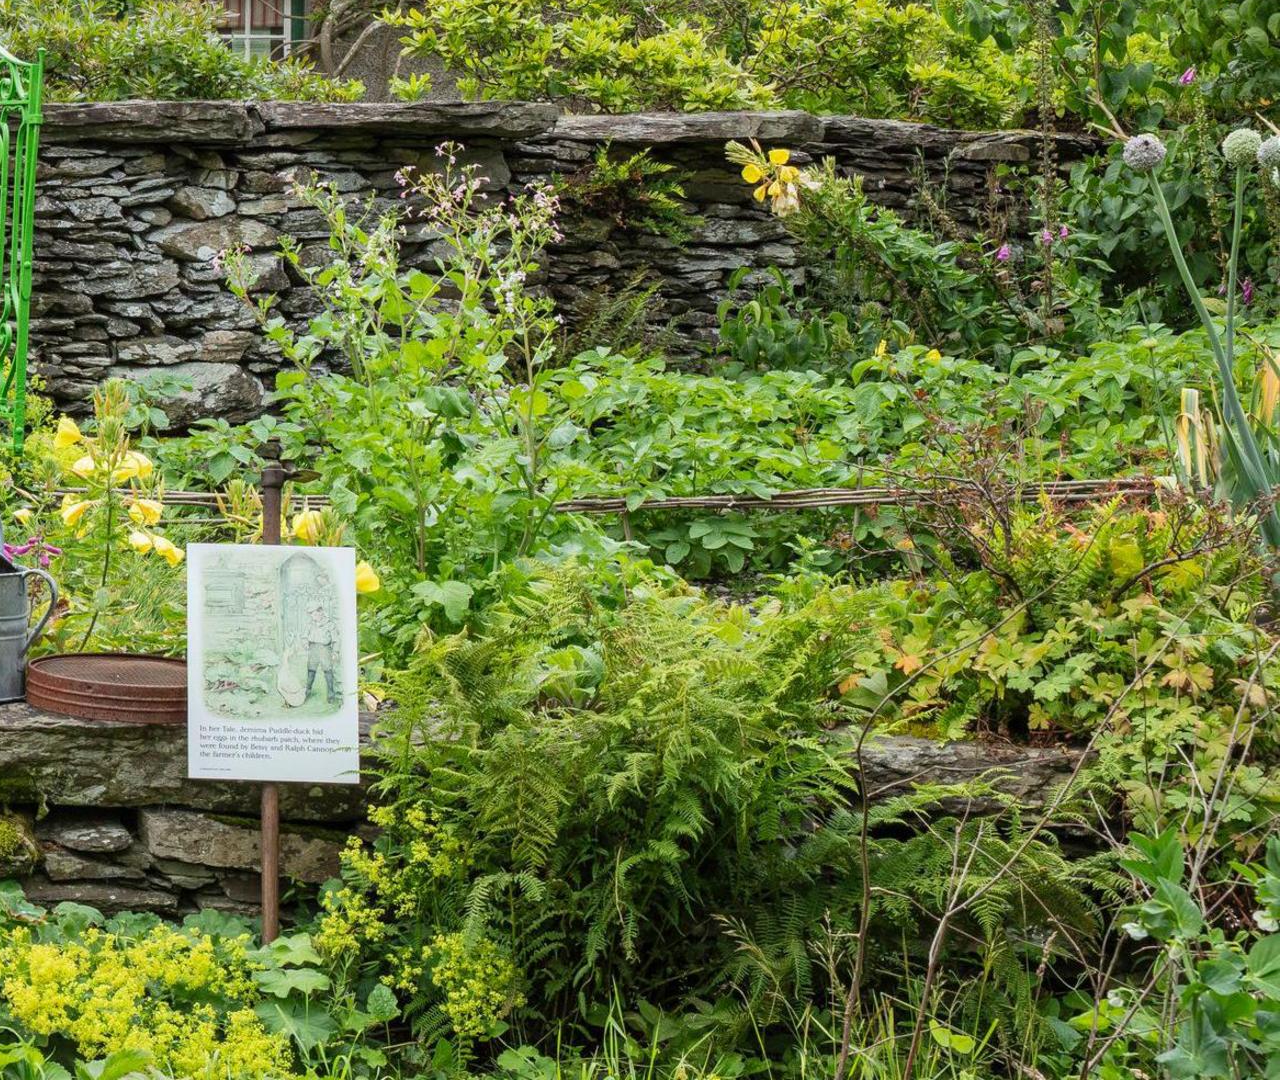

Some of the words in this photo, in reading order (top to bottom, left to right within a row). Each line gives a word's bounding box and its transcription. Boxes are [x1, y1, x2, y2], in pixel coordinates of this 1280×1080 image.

[239, 726, 267, 734] Jemima
[269, 727, 311, 735] Puddle-duck
[285, 744, 305, 753] Ralph
